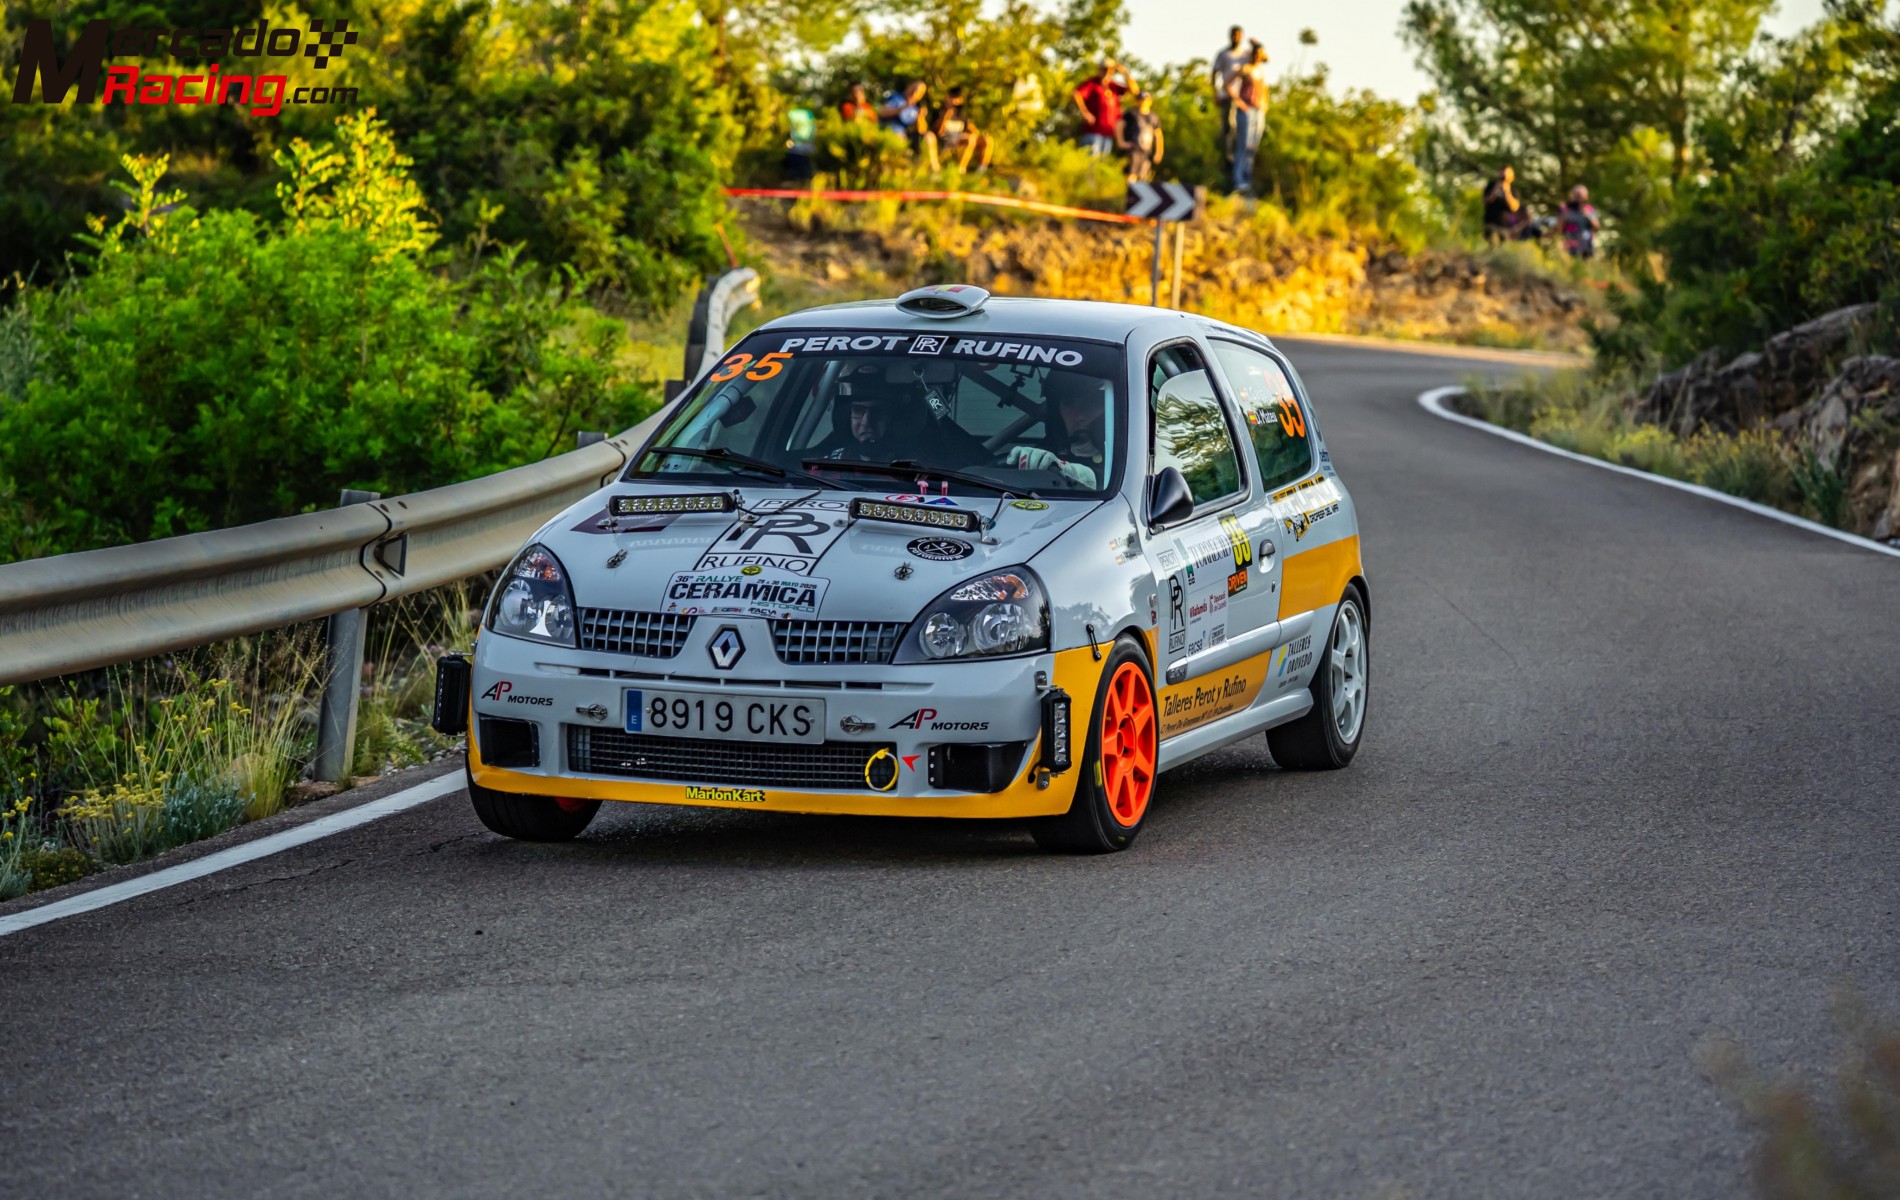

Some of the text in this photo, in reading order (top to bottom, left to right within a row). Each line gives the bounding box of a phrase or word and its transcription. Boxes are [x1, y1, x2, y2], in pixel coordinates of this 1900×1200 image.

[779, 336, 909, 353] PEROT
[952, 339, 1083, 366] RUFINO
[709, 353, 794, 382] 35
[1187, 535, 1232, 568] TORRECID
[1221, 516, 1251, 566] 35
[702, 556, 808, 571] RUFINO
[695, 575, 744, 583] RALLYE
[669, 582, 816, 607] CERAMICA
[750, 601, 815, 613] HISTORICO
[1169, 633, 1184, 649] RUFINO
[1288, 635, 1311, 657] TALLERES
[482, 681, 553, 706] AP MOTORS
[1164, 675, 1246, 717] Talleres Perot y Rufino
[631, 715, 637, 724] E
[651, 697, 811, 736] 8919 CKS
[888, 709, 989, 731] AP MOTORS
